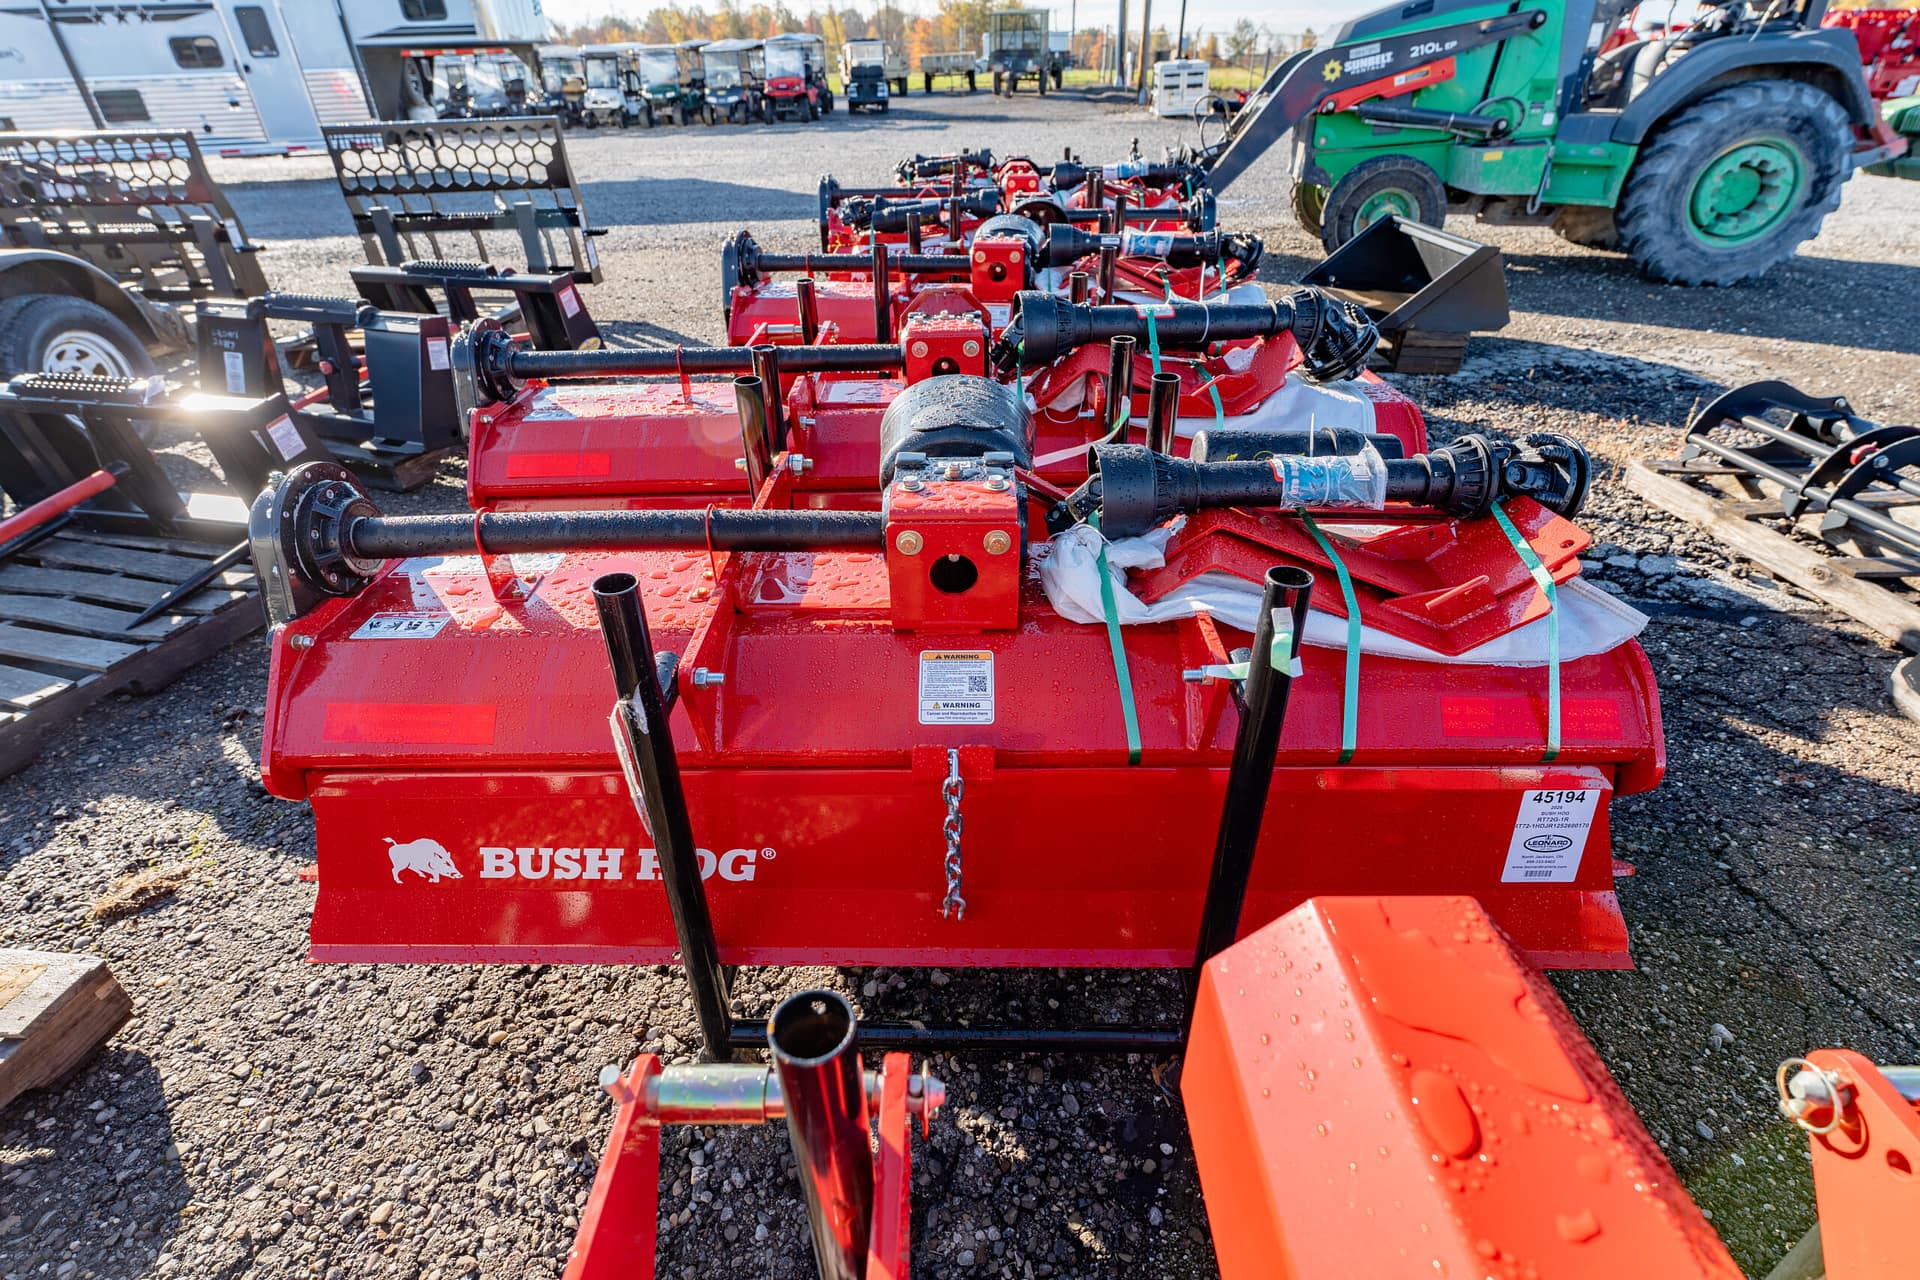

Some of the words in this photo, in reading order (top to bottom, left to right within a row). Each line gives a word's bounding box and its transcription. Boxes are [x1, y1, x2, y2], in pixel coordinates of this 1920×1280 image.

[1410, 42, 1443, 58] 210L
[1344, 51, 1393, 73] SUNBELT
[1533, 791, 1586, 803] 45194
[479, 847, 625, 880] BUSH
